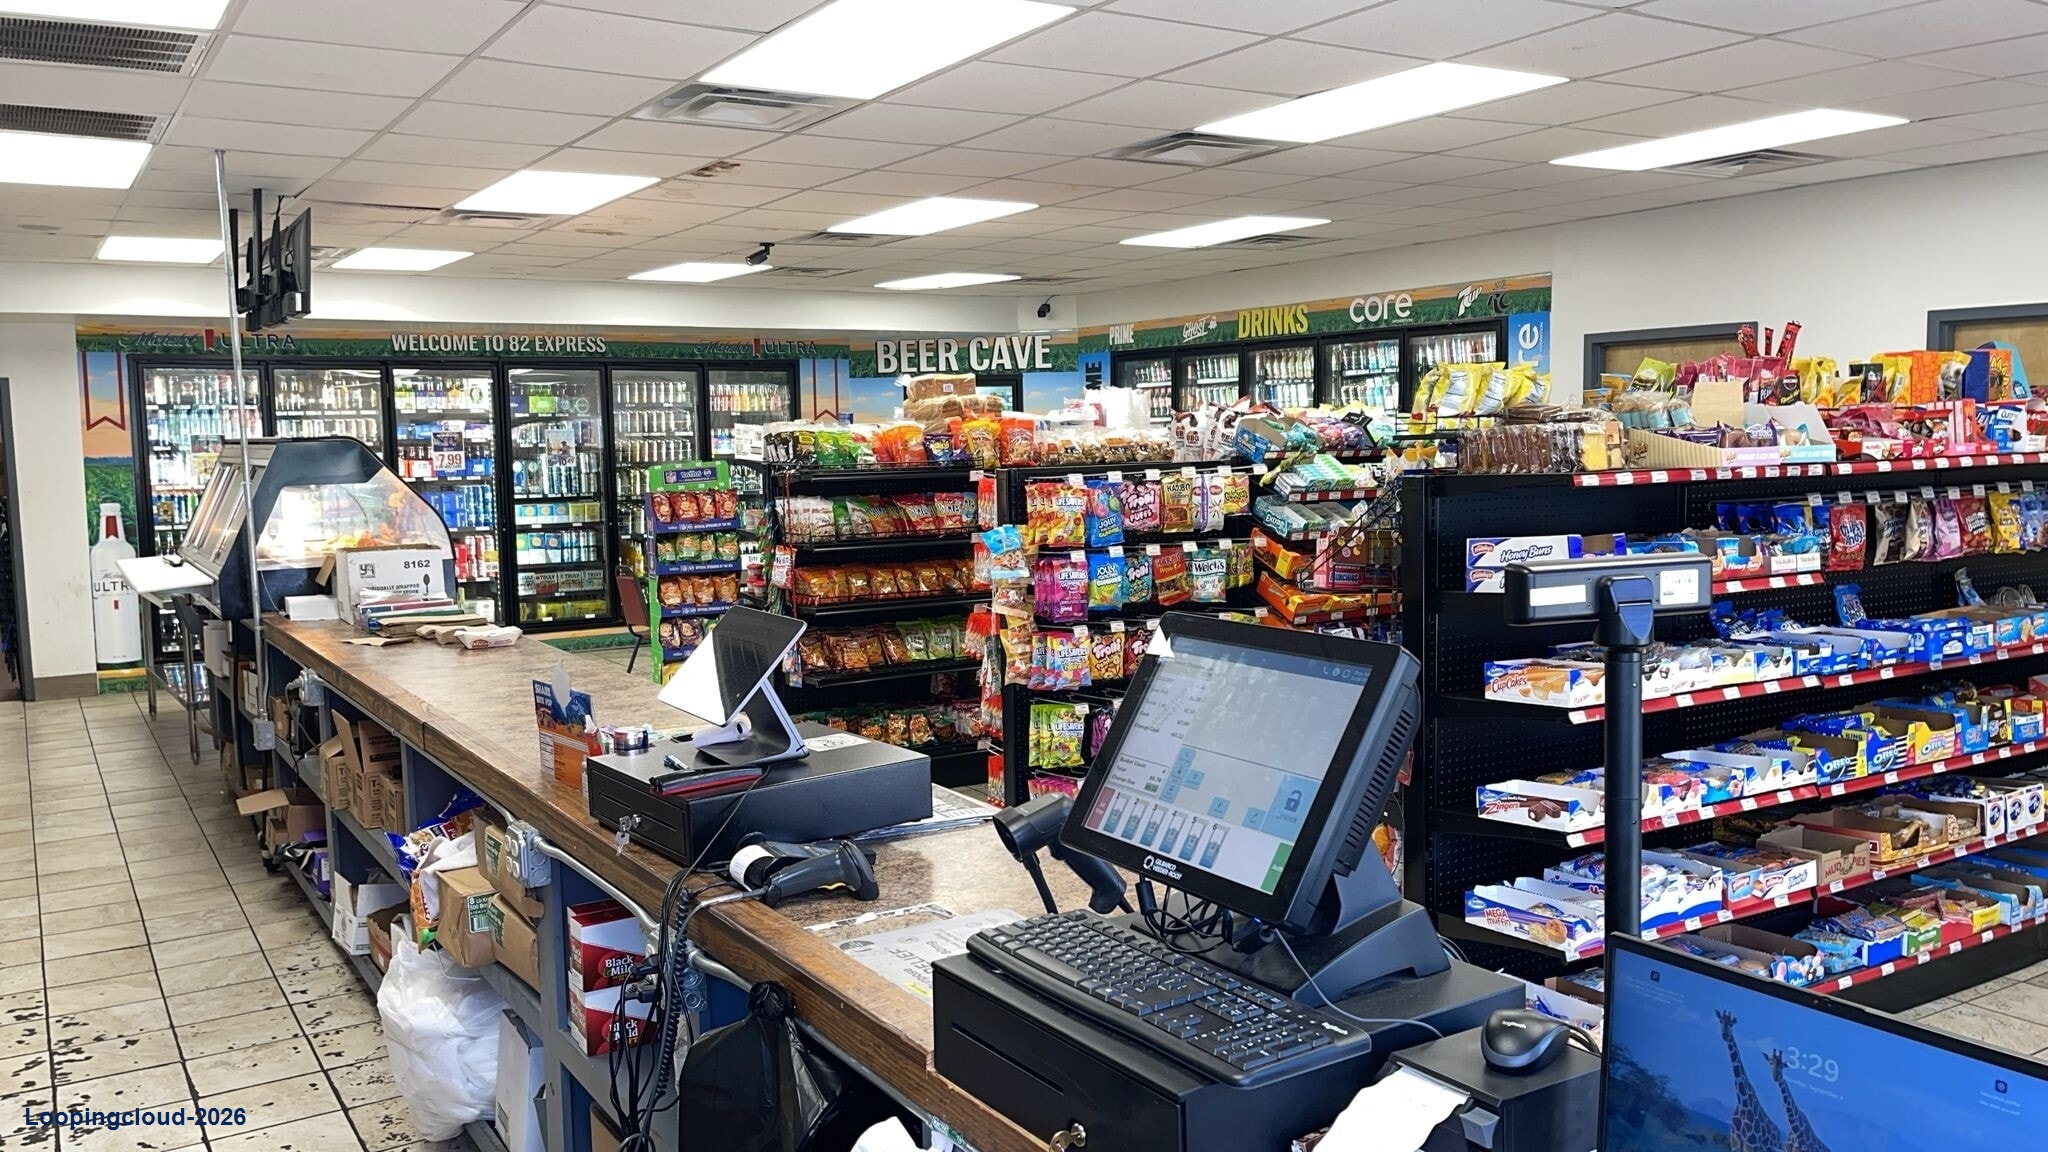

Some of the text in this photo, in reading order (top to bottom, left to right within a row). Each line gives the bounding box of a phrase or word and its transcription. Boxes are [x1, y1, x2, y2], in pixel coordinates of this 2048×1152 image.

[1350, 293, 1413, 323] core
[1182, 315, 1211, 342] GHOST
[1238, 305, 1308, 339] DRINKS
[221, 333, 296, 349] ULTRA
[1109, 324, 1134, 345] PRIME
[391, 334, 606, 353] WELCOME TO 82 EXPRESS
[764, 340, 817, 354] ULTRA
[876, 335, 1053, 374] BEER CAVE
[1167, 484, 1191, 492] HARIBO
[1127, 490, 1155, 509] Trolli
[1099, 516, 1117, 529] JOLLY
[1500, 549, 1528, 563] Honey
[1529, 545, 1553, 559] Buns
[403, 559, 431, 569] 8162
[1097, 563, 1118, 575] JOLLY
[1194, 560, 1225, 572] Welch's
[1127, 562, 1149, 582] Trolli
[94, 581, 134, 592] ULTR
[1092, 638, 1121, 660] Trolli
[1491, 676, 1528, 693] CupCakes
[1922, 738, 1948, 755] OREO
[1874, 747, 1899, 765] OREO
[1824, 755, 1850, 773] OREO
[1134, 798, 1139, 806] 2
[1152, 804, 1158, 812] 3
[1485, 802, 1520, 815] Zingers
[1172, 810, 1177, 818] 4
[1192, 816, 1198, 824] 5
[1212, 823, 1218, 831] 6
[1155, 858, 1177, 871] GILBARCO
[1825, 856, 1867, 879] MUD PIES
[1152, 865, 1183, 880] VEEDER-ROOT
[469, 897, 475, 905] 8
[1484, 908, 1508, 918] MEGA
[1486, 918, 1511, 926] muffin
[605, 955, 634, 968] Black
[614, 1029, 639, 1040] Mld
[1786, 1046, 1839, 1083] 3:29
